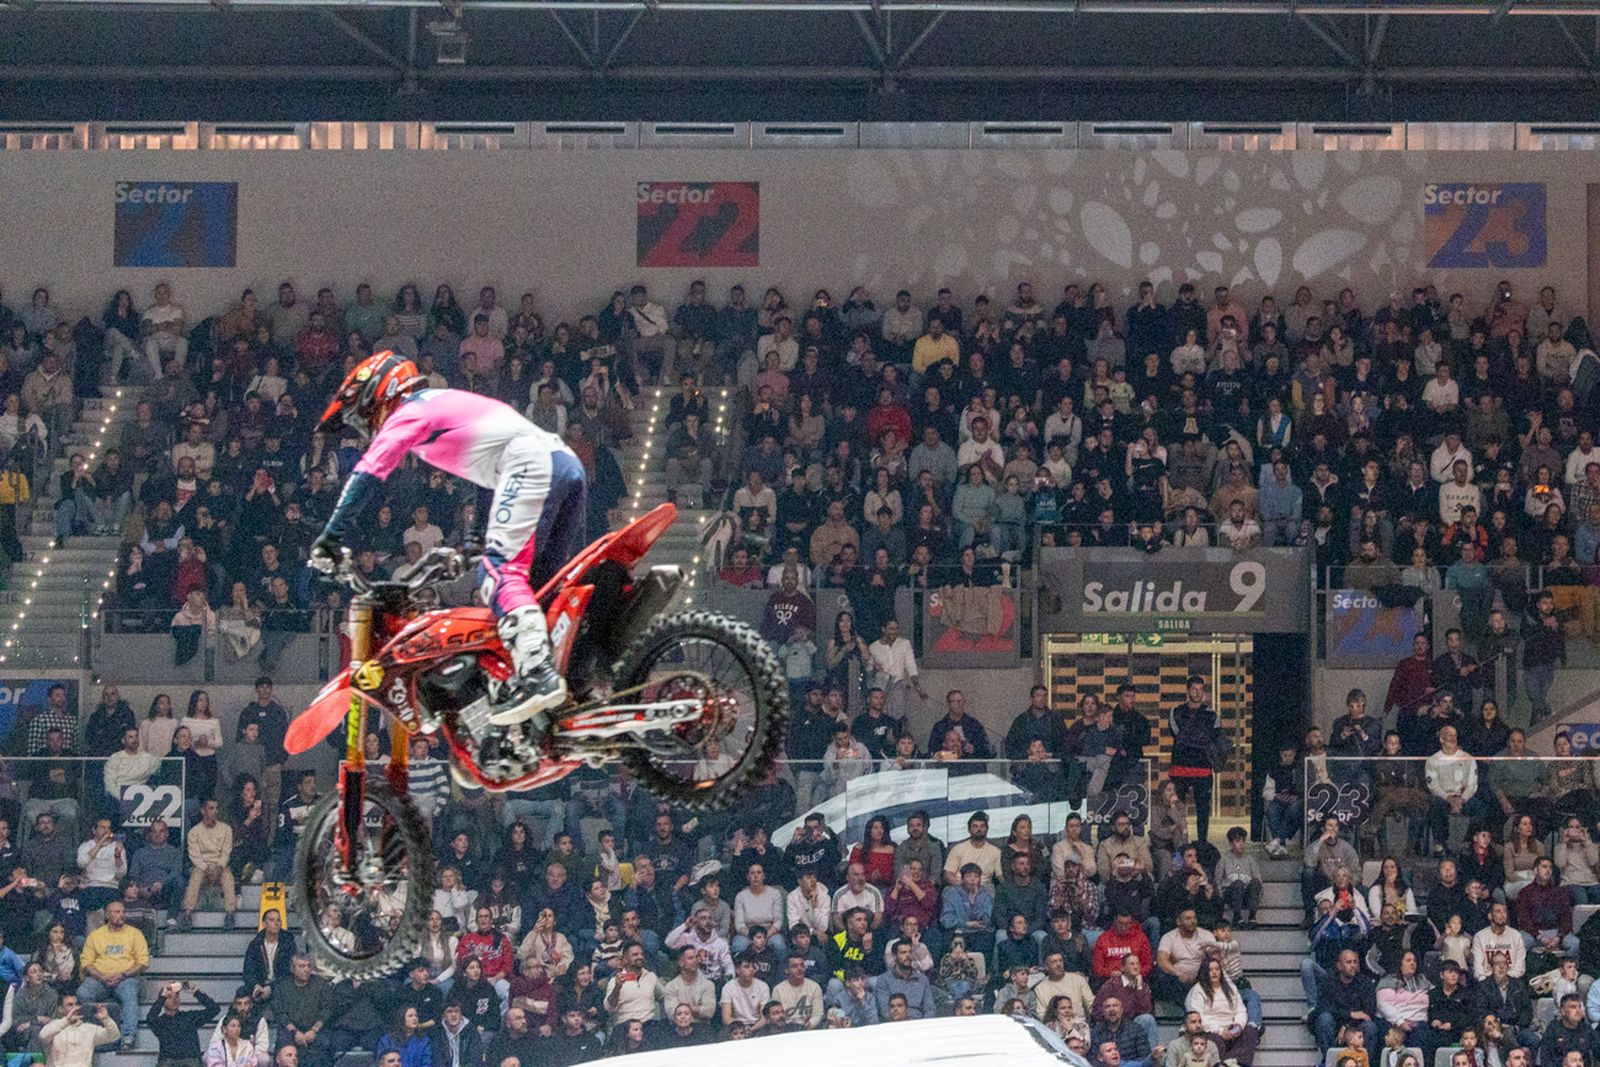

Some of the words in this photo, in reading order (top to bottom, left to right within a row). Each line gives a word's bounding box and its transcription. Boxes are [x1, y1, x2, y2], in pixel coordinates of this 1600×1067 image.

[115, 182, 193, 204] Sector
[637, 182, 715, 204] Sector
[1424, 184, 1502, 205] Sector
[637, 182, 759, 267] 22
[1424, 182, 1547, 268] 23
[1083, 581, 1207, 612] Salida
[1229, 561, 1266, 612] 9
[1332, 594, 1381, 609] Secto
[1158, 619, 1190, 629] SALIDA
[122, 784, 182, 827] 22
[1308, 782, 1370, 825] 23
[127, 815, 164, 824] ector
[1307, 808, 1353, 822] Seor
